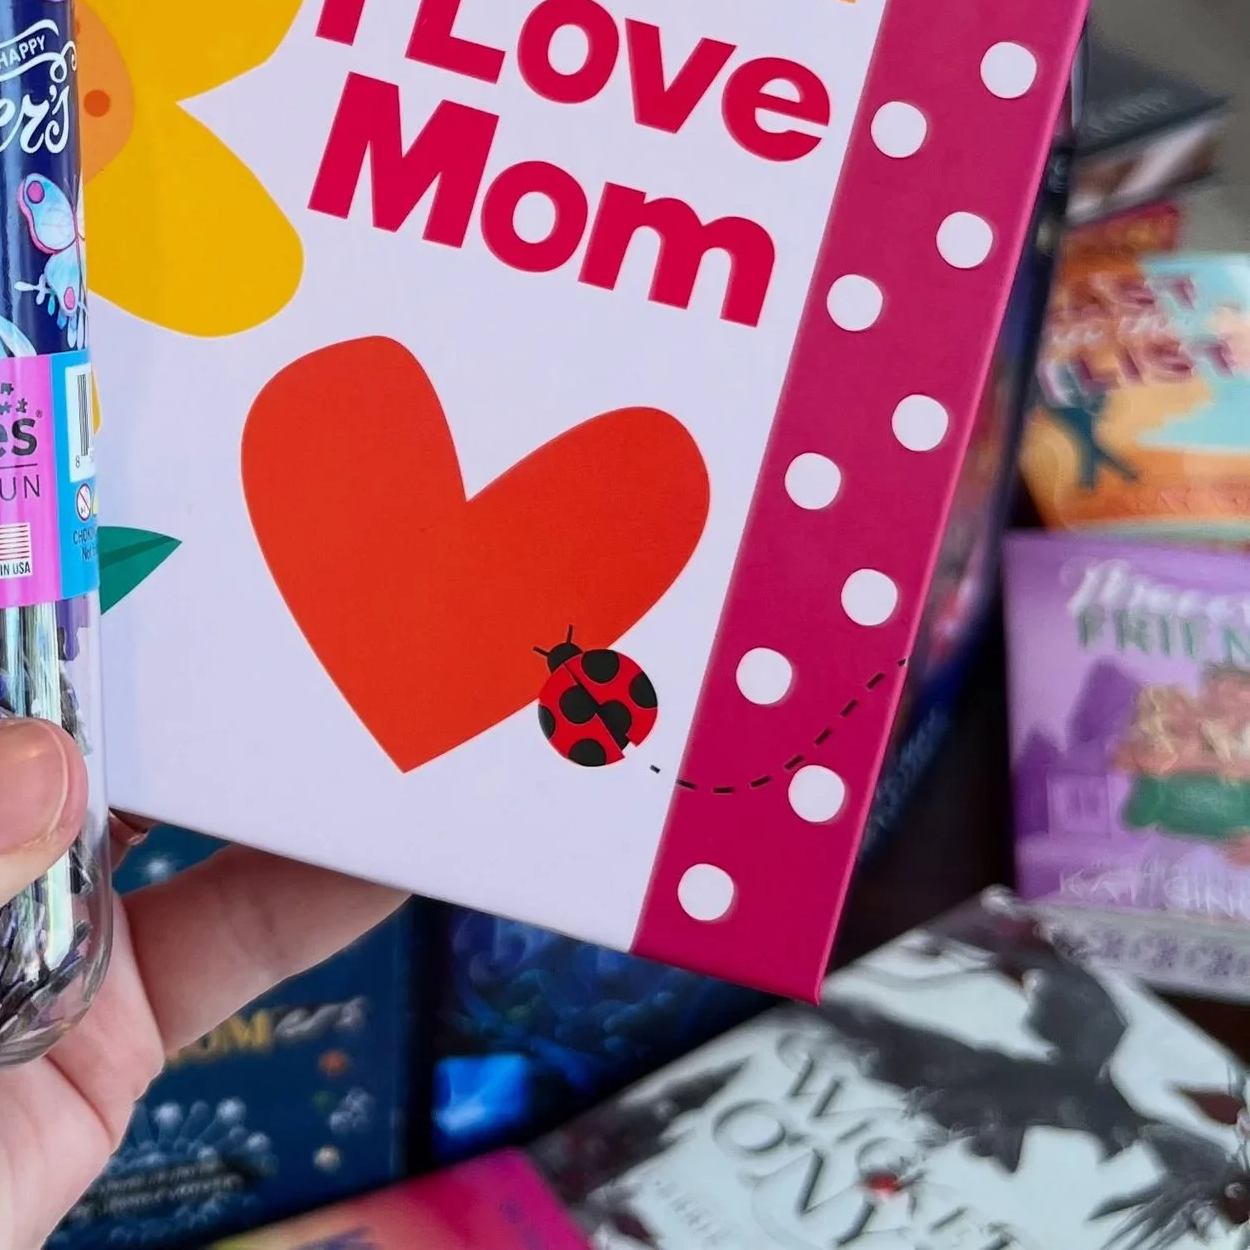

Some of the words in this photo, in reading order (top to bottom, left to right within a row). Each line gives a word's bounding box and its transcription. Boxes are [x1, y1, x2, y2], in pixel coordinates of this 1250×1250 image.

[307, 70, 776, 328] Mom
[0, 563, 10, 576] IN
[13, 561, 31, 574] USA
